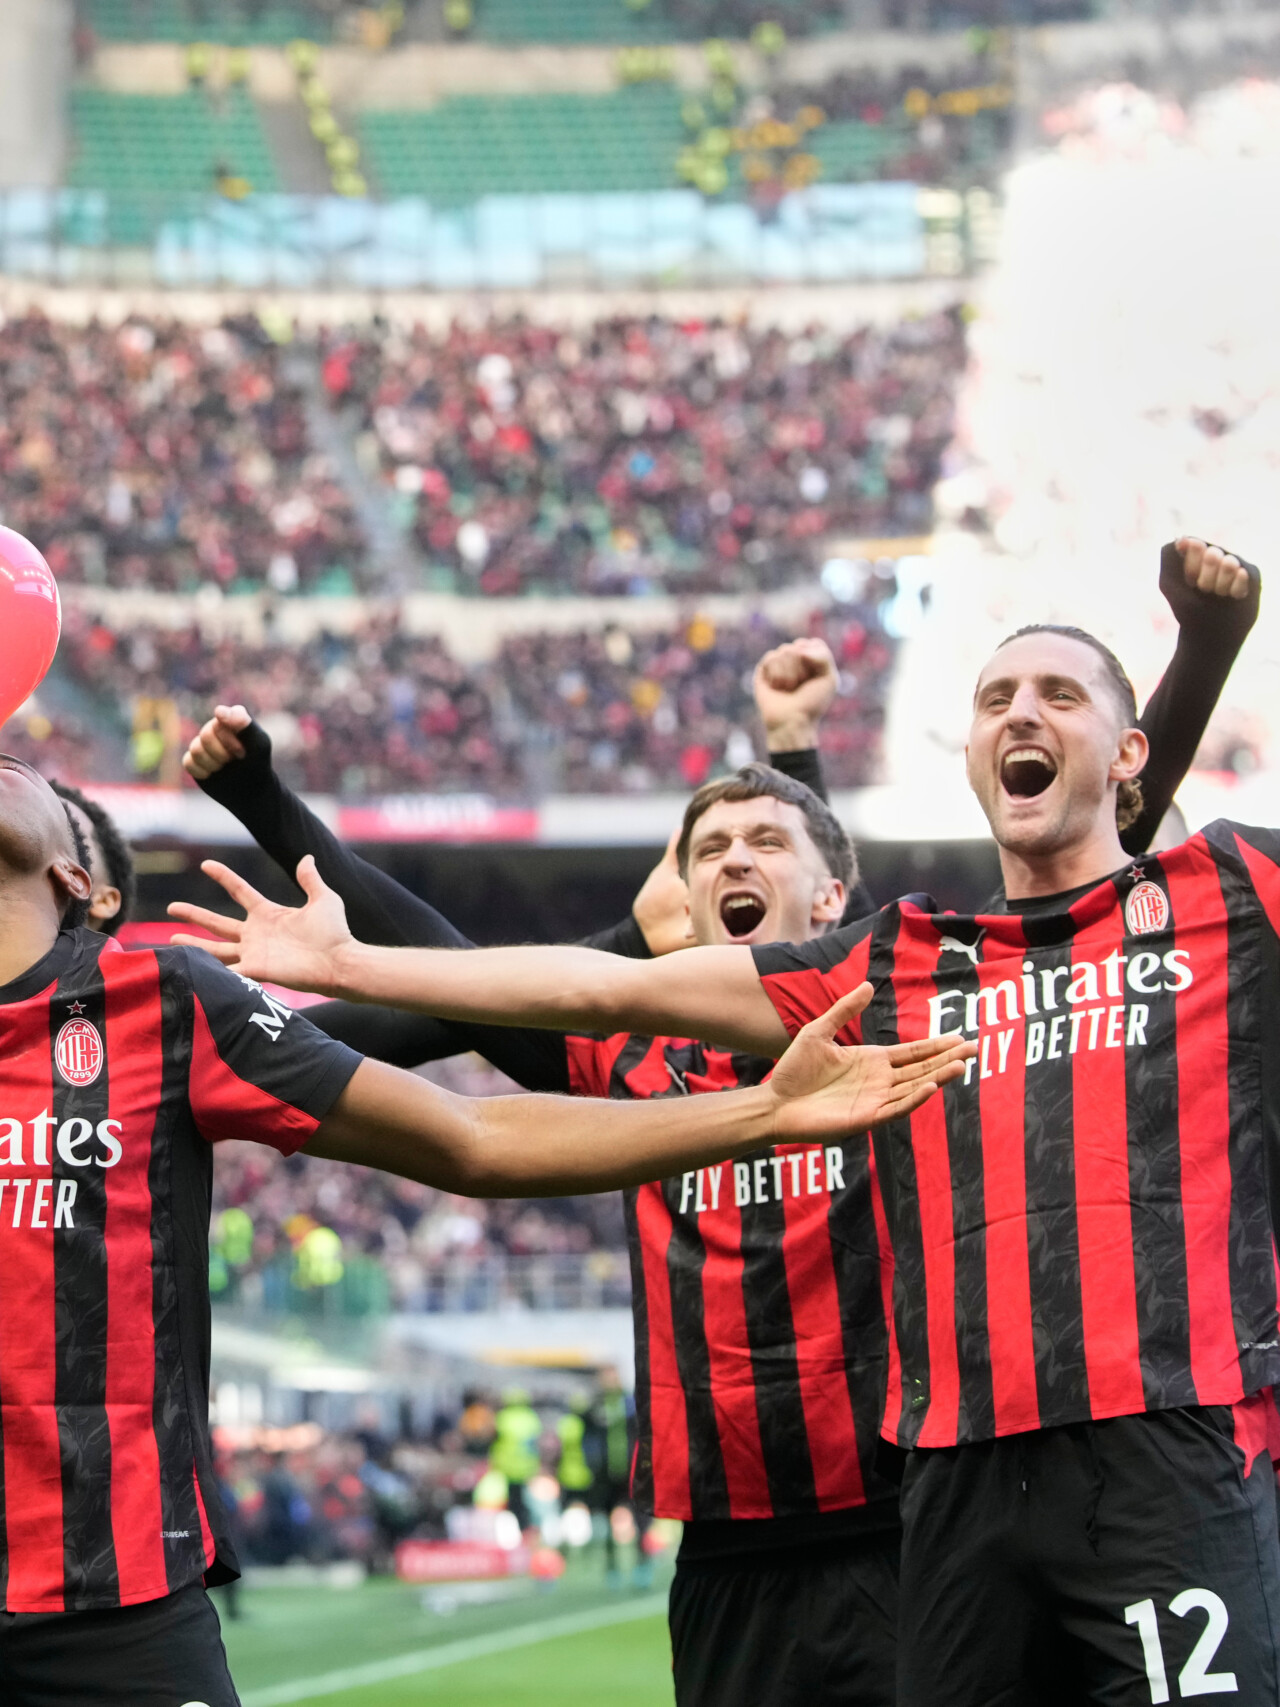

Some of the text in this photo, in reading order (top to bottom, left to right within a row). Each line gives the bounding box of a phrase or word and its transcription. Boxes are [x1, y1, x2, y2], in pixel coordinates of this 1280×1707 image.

[927, 948, 1194, 1039] Emirates
[65, 1023, 92, 1038] ACM
[1025, 1003, 1150, 1067] BETTER
[68, 1070, 92, 1079] 1899
[678, 1146, 846, 1215] FLY BETTER
[1124, 1588, 1239, 1705] 12
